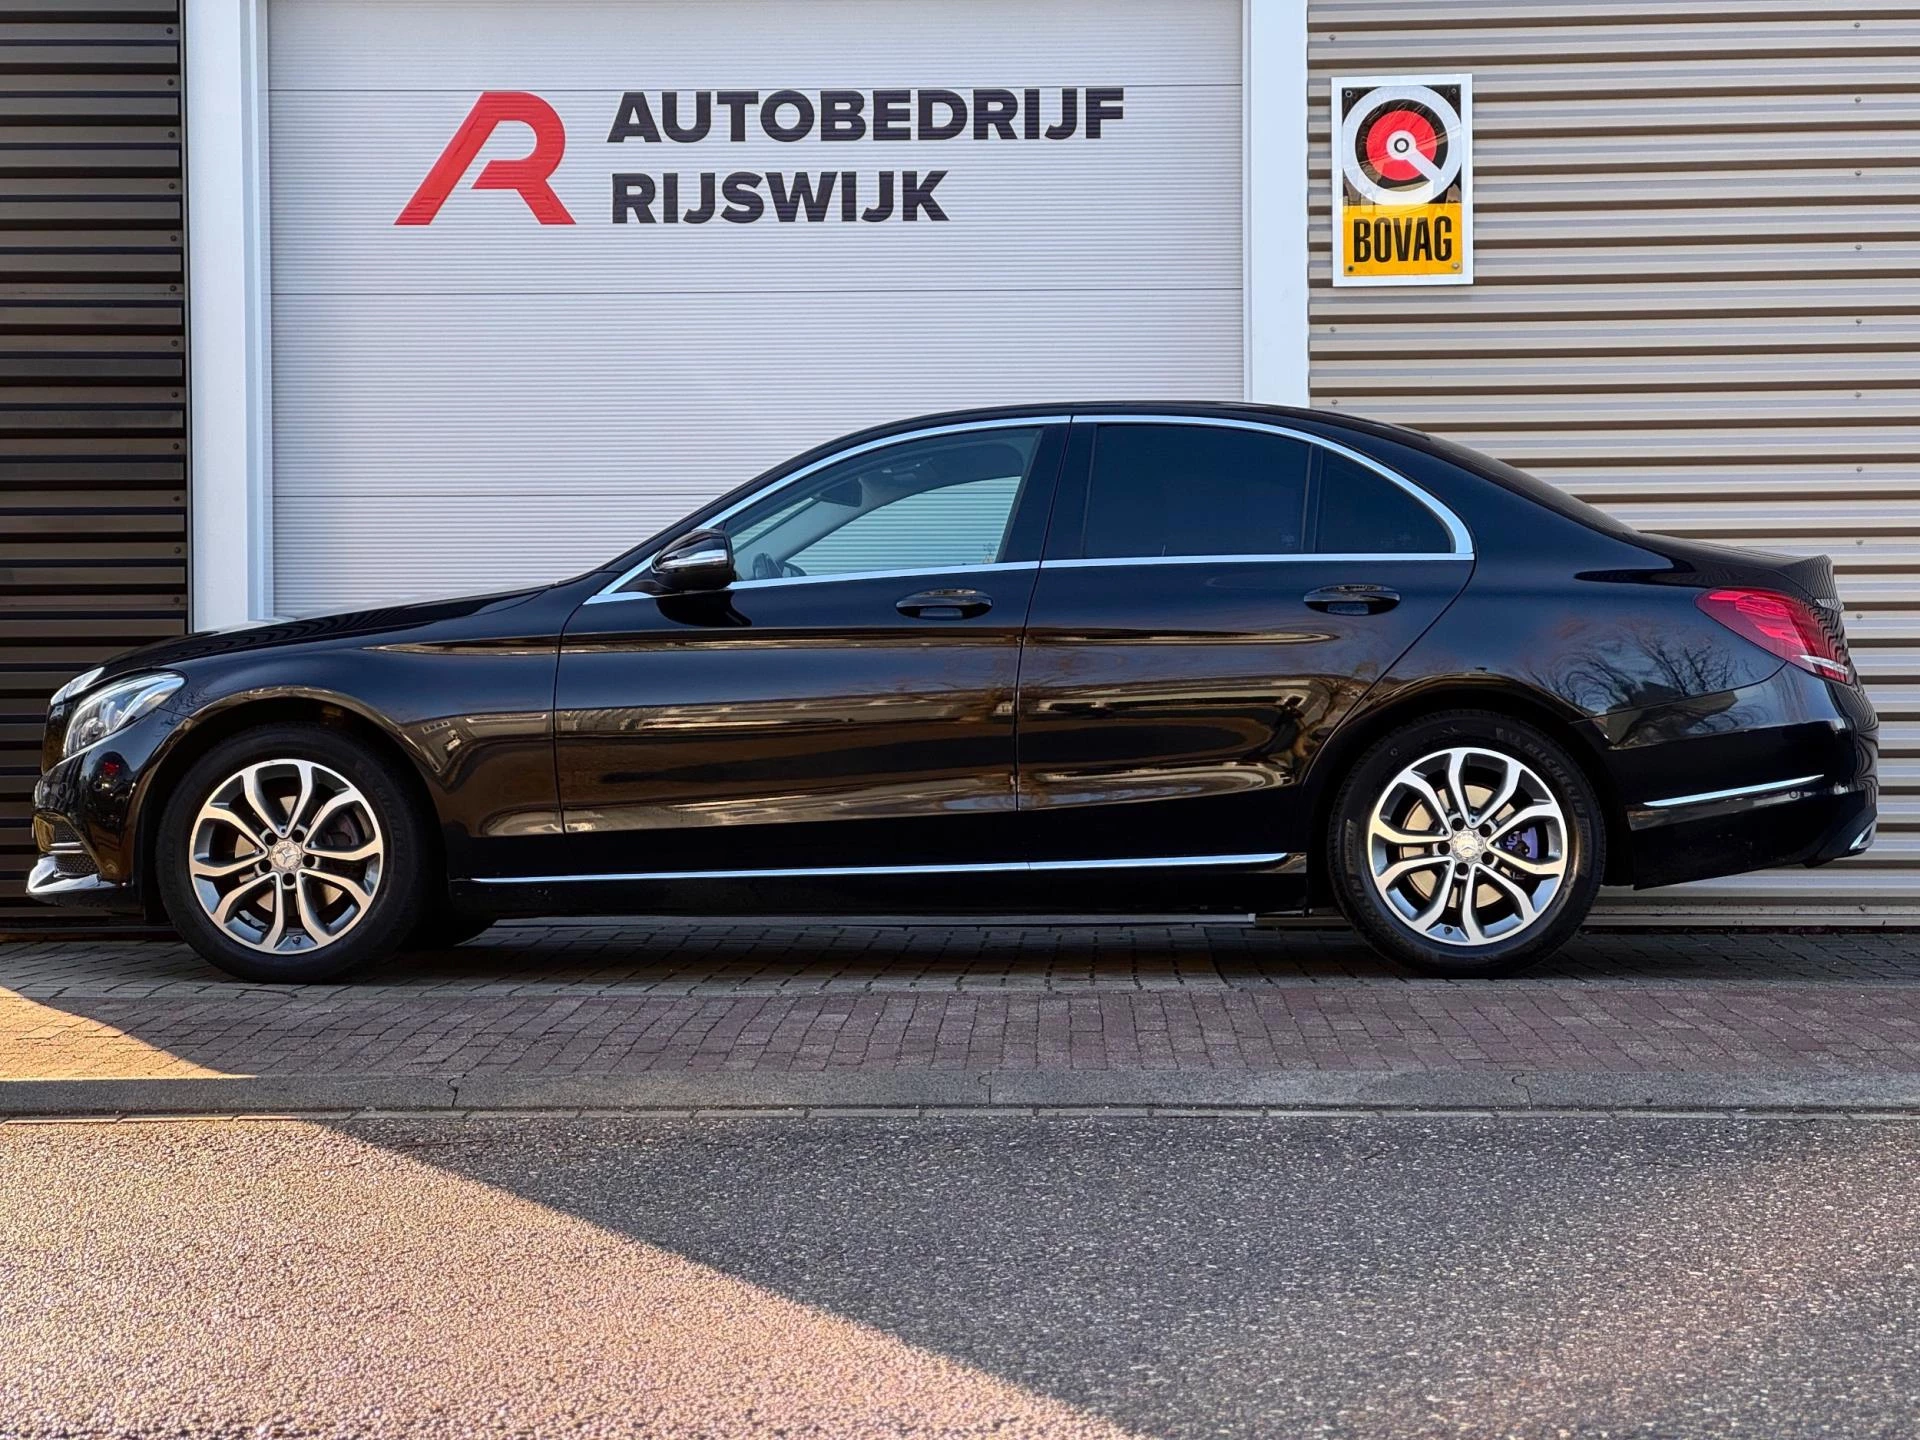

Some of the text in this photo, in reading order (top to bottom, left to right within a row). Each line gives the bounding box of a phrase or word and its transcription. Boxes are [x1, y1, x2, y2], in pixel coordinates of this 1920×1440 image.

[607, 87, 1124, 143] AUTOBEDRIJF
[611, 171, 950, 225] RIJSWIJK
[1353, 215, 1453, 263] BOVAG
[1524, 742, 1587, 818] MICHELIN
